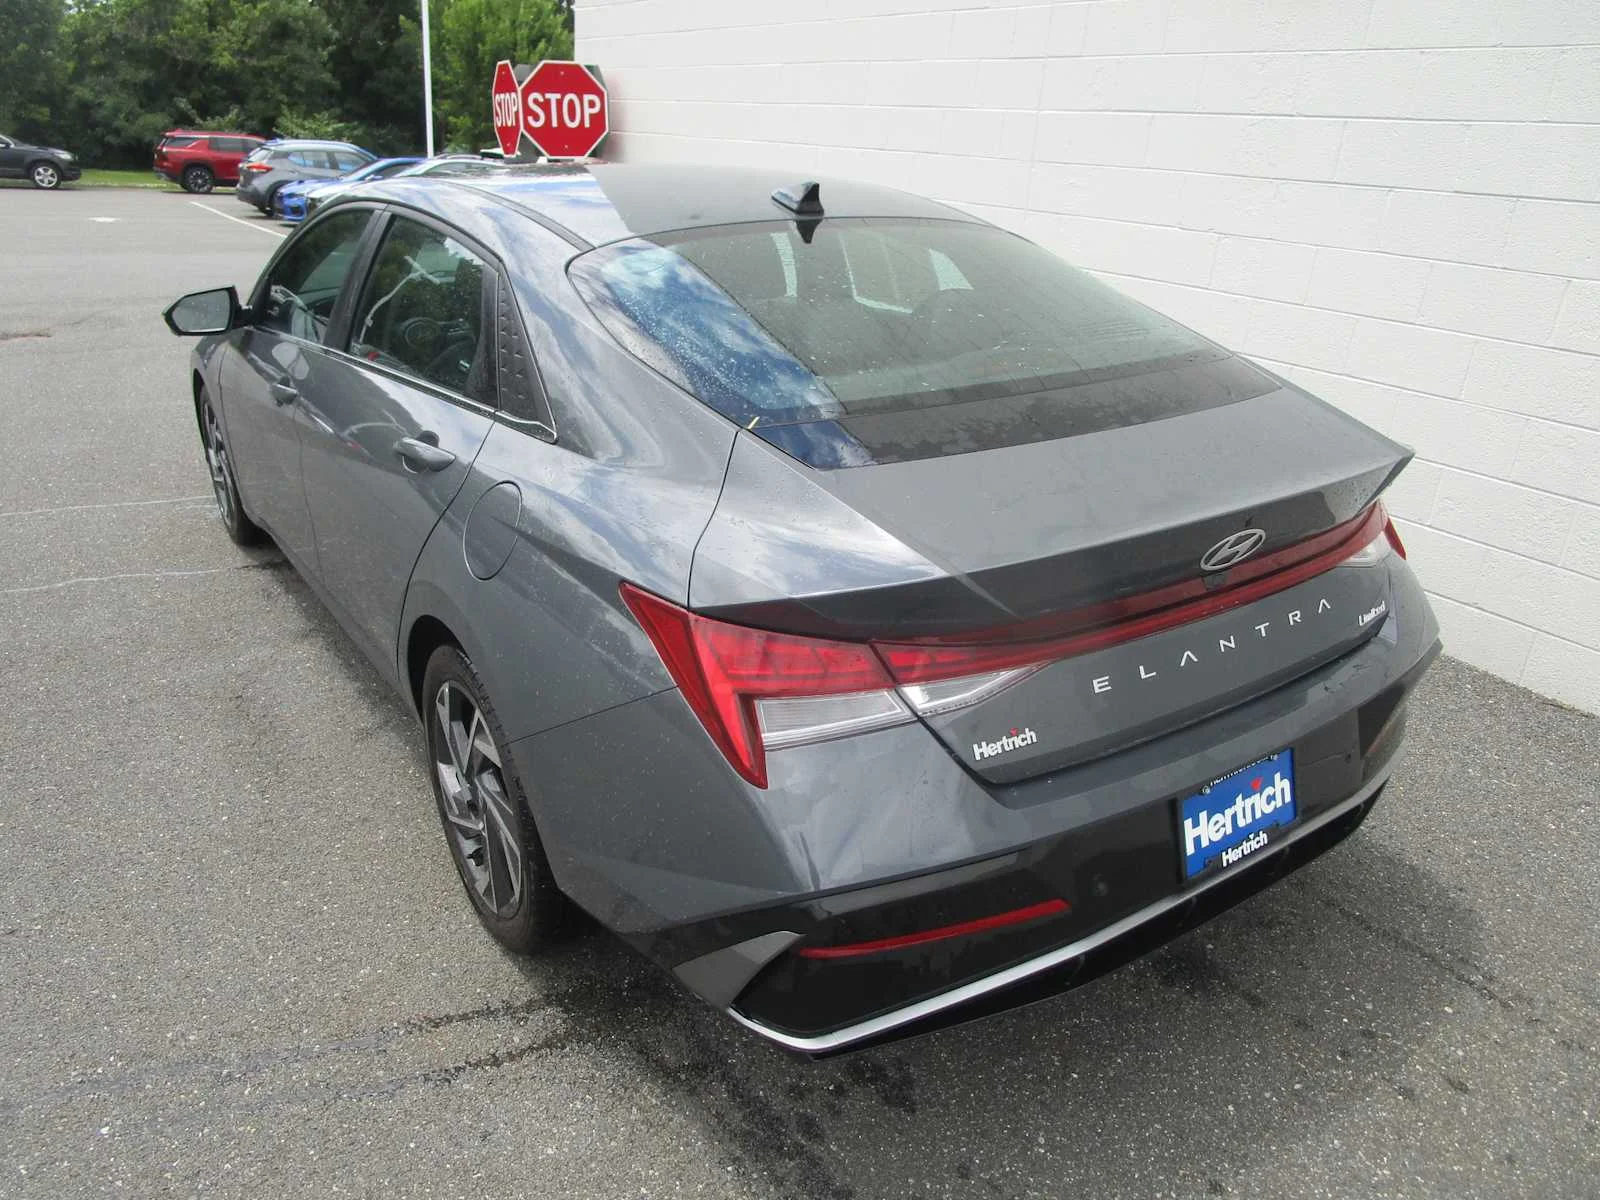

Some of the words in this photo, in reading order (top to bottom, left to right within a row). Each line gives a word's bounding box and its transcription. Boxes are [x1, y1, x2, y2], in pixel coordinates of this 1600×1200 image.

[495, 92, 518, 127] STOP
[527, 92, 601, 128] STOP
[1092, 598, 1331, 694] ELANTRA
[972, 727, 1037, 761] Hertrich
[1183, 771, 1292, 856] Hertrich
[1221, 830, 1269, 867] Hertrich
